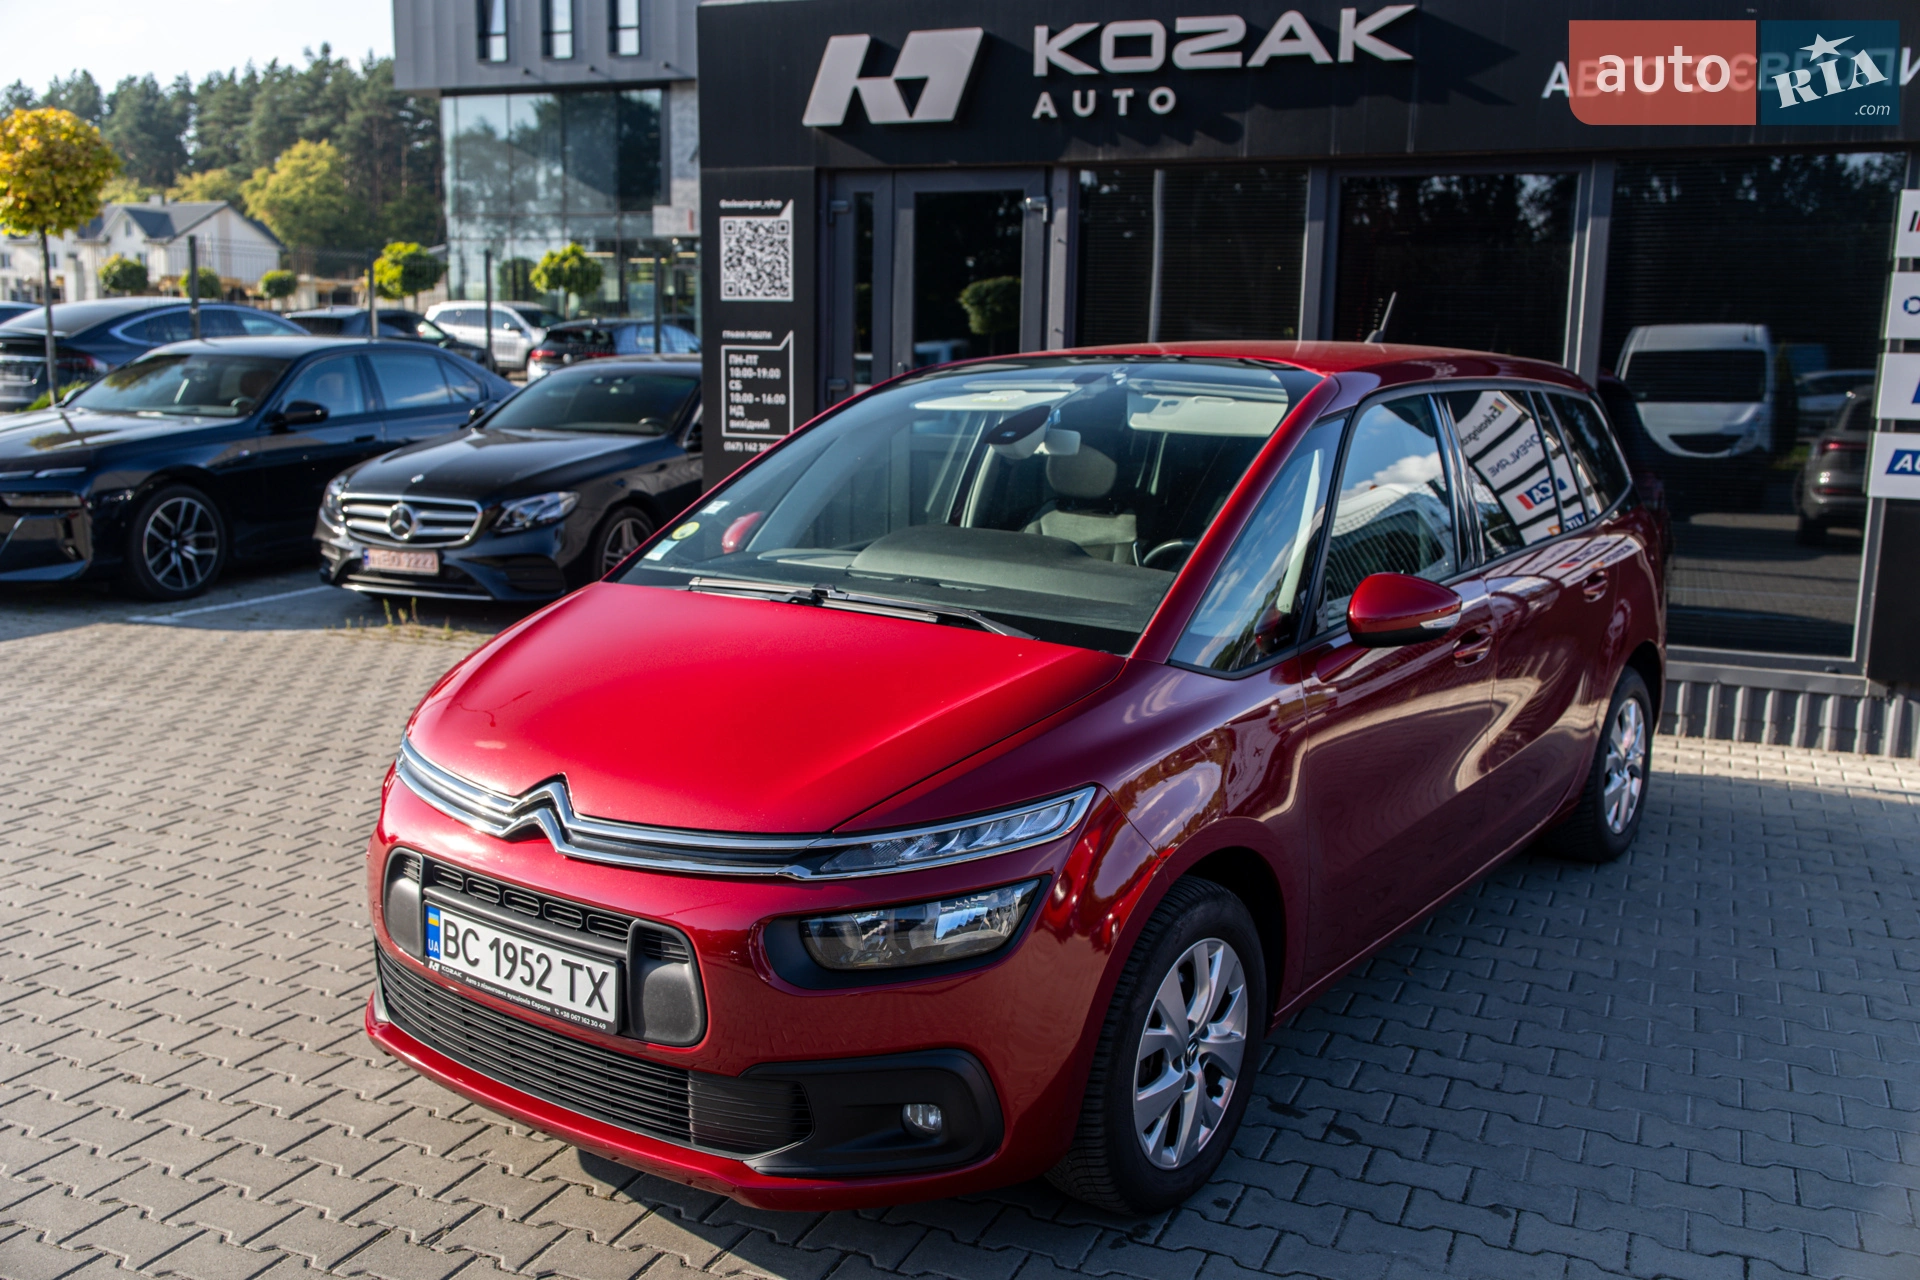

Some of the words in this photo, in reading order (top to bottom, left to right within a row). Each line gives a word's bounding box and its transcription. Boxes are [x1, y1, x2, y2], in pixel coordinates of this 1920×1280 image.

[1033, 5, 1416, 77] KOZAK
[1032, 86, 1177, 120] AUTO
[728, 354, 759, 366] ПН-ПТ
[729, 366, 781, 379] 10:00-19:00
[728, 379, 743, 391] СБ
[730, 392, 754, 404] 10:00
[762, 393, 787, 405] 16:00
[428, 937, 439, 954] UA
[443, 918, 480, 967] BC
[488, 937, 553, 994] 1952
[561, 958, 609, 1014] TX
